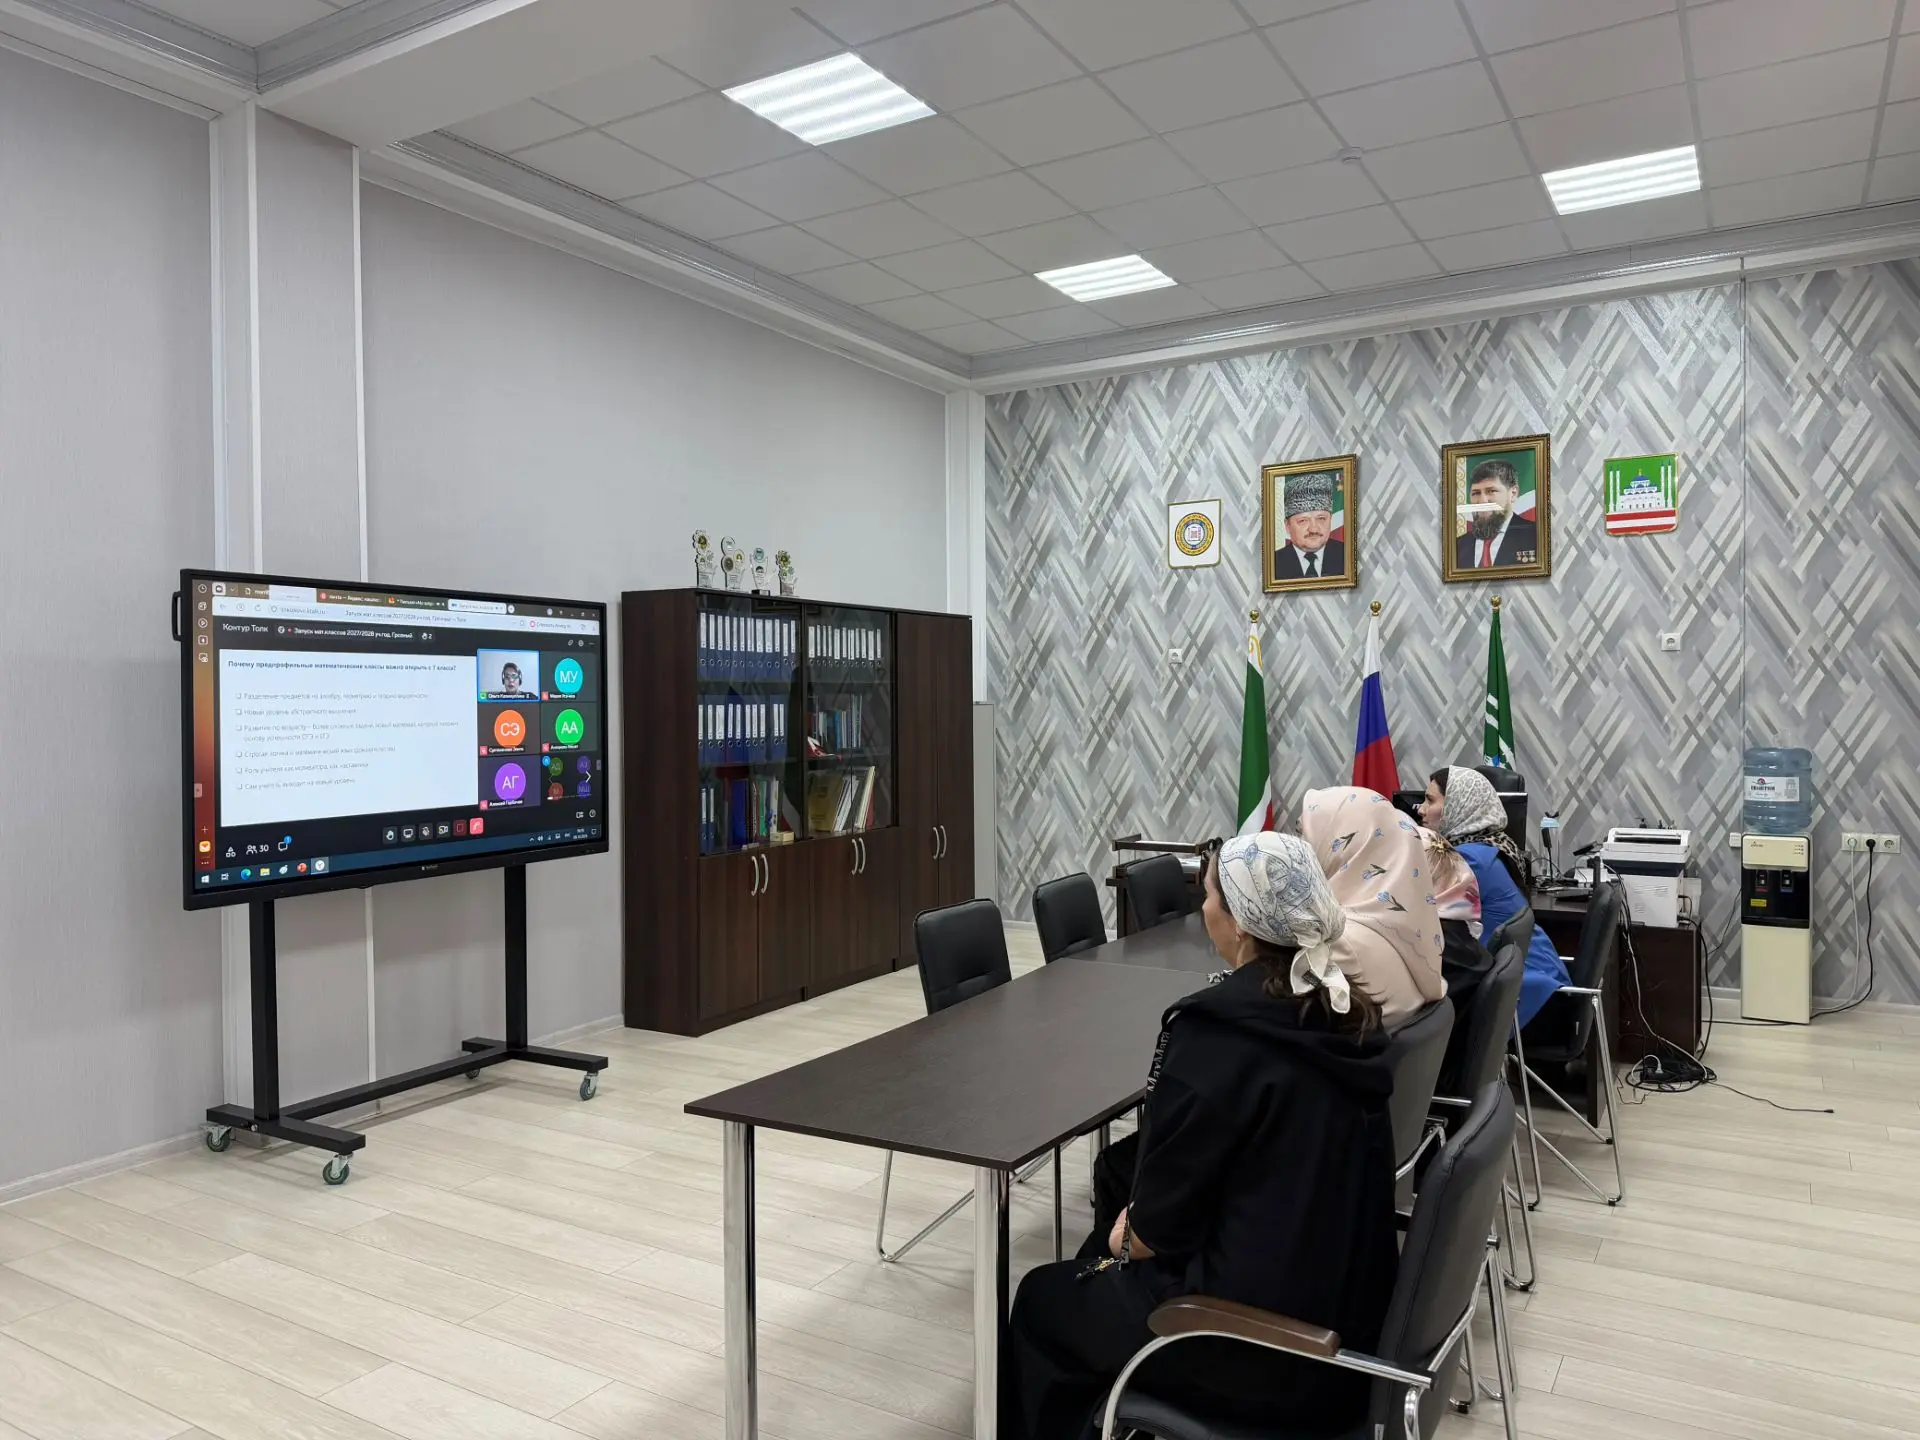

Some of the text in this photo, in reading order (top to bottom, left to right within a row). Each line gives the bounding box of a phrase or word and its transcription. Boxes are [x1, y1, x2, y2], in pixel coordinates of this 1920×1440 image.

[222, 624, 268, 633] Контур Толк
[294, 627, 313, 636] Запуск
[560, 670, 578, 684] МУ
[500, 722, 520, 736] СЭ
[561, 720, 578, 734] АА
[502, 776, 520, 790] АГ
[260, 844, 269, 852] 30
